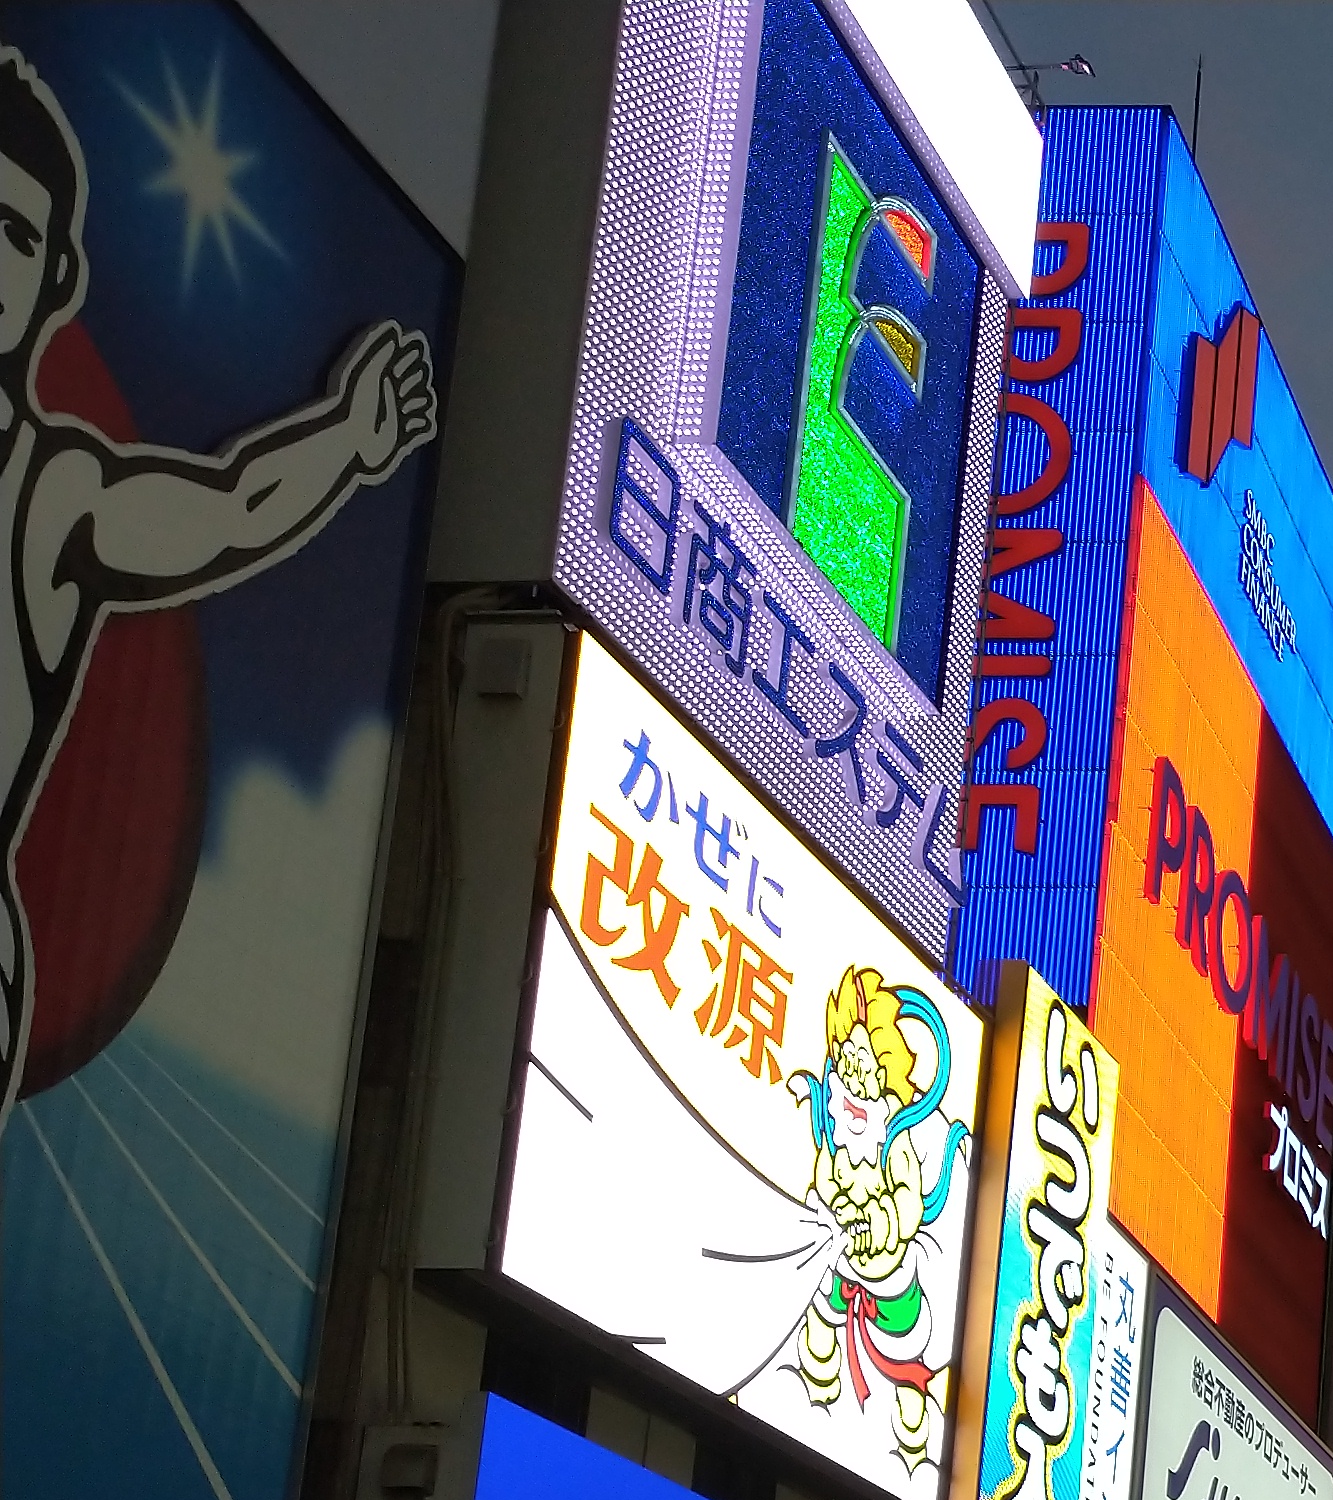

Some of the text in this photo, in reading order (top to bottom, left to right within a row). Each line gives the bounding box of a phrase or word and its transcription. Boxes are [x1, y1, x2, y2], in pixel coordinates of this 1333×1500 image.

[1240, 524, 1298, 654] CONSUMER
[1242, 488, 1276, 567] SMBC
[1238, 562, 1287, 663] FINANCE
[618, 728, 786, 937] かぜに
[578, 802, 795, 1086] 改源
[1262, 1101, 1329, 1238] プロミス
[1191, 1352, 1318, 1497] 総合不動産のプロデューサー
